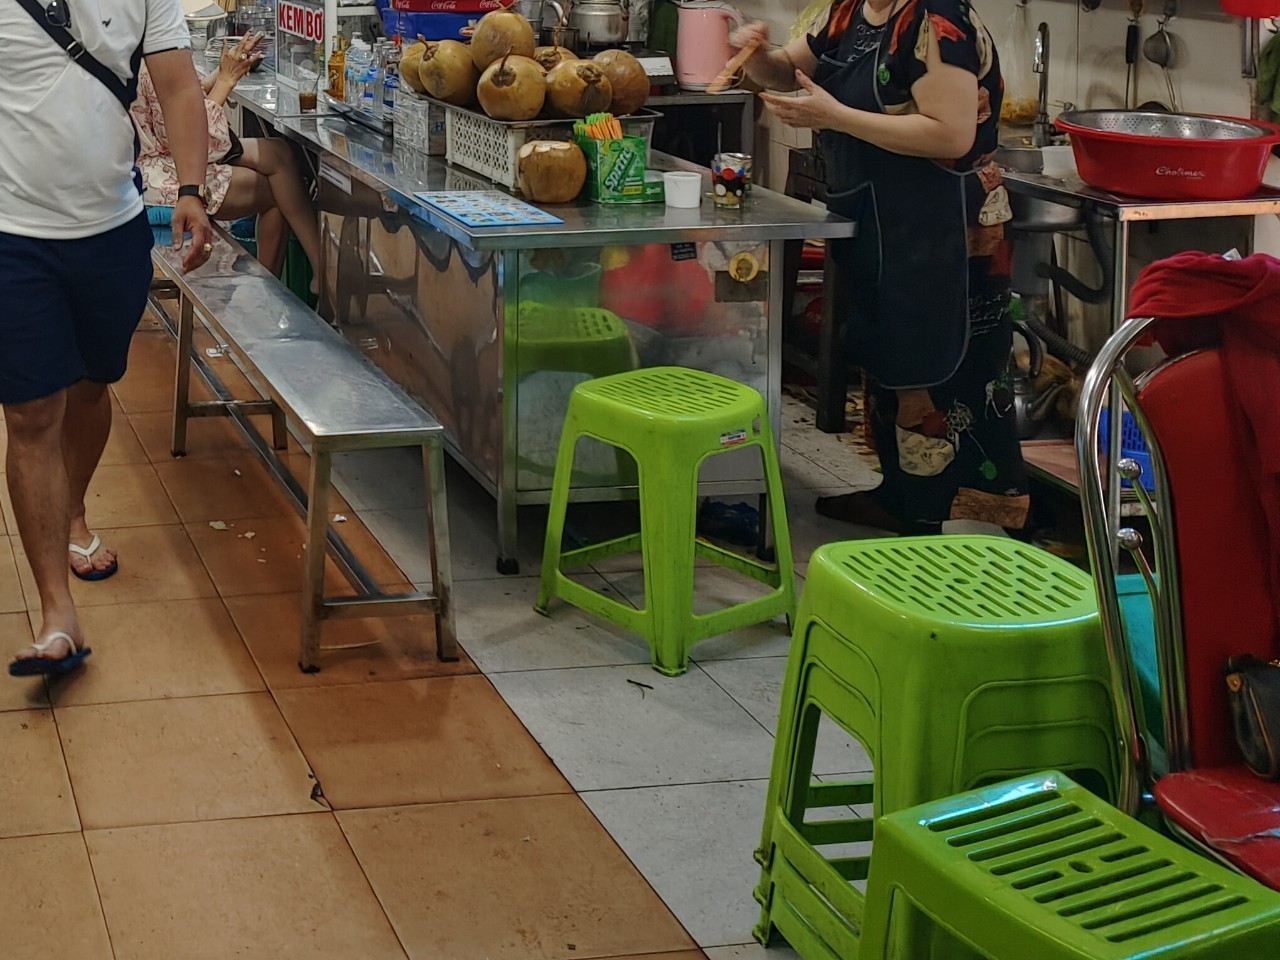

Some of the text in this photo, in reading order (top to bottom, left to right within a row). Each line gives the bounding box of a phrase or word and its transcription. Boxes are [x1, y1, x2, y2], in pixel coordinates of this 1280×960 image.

[279, 2, 323, 41] KEM BƠ
[604, 148, 630, 192] Sprite
[1155, 166, 1206, 178] Cholimex
